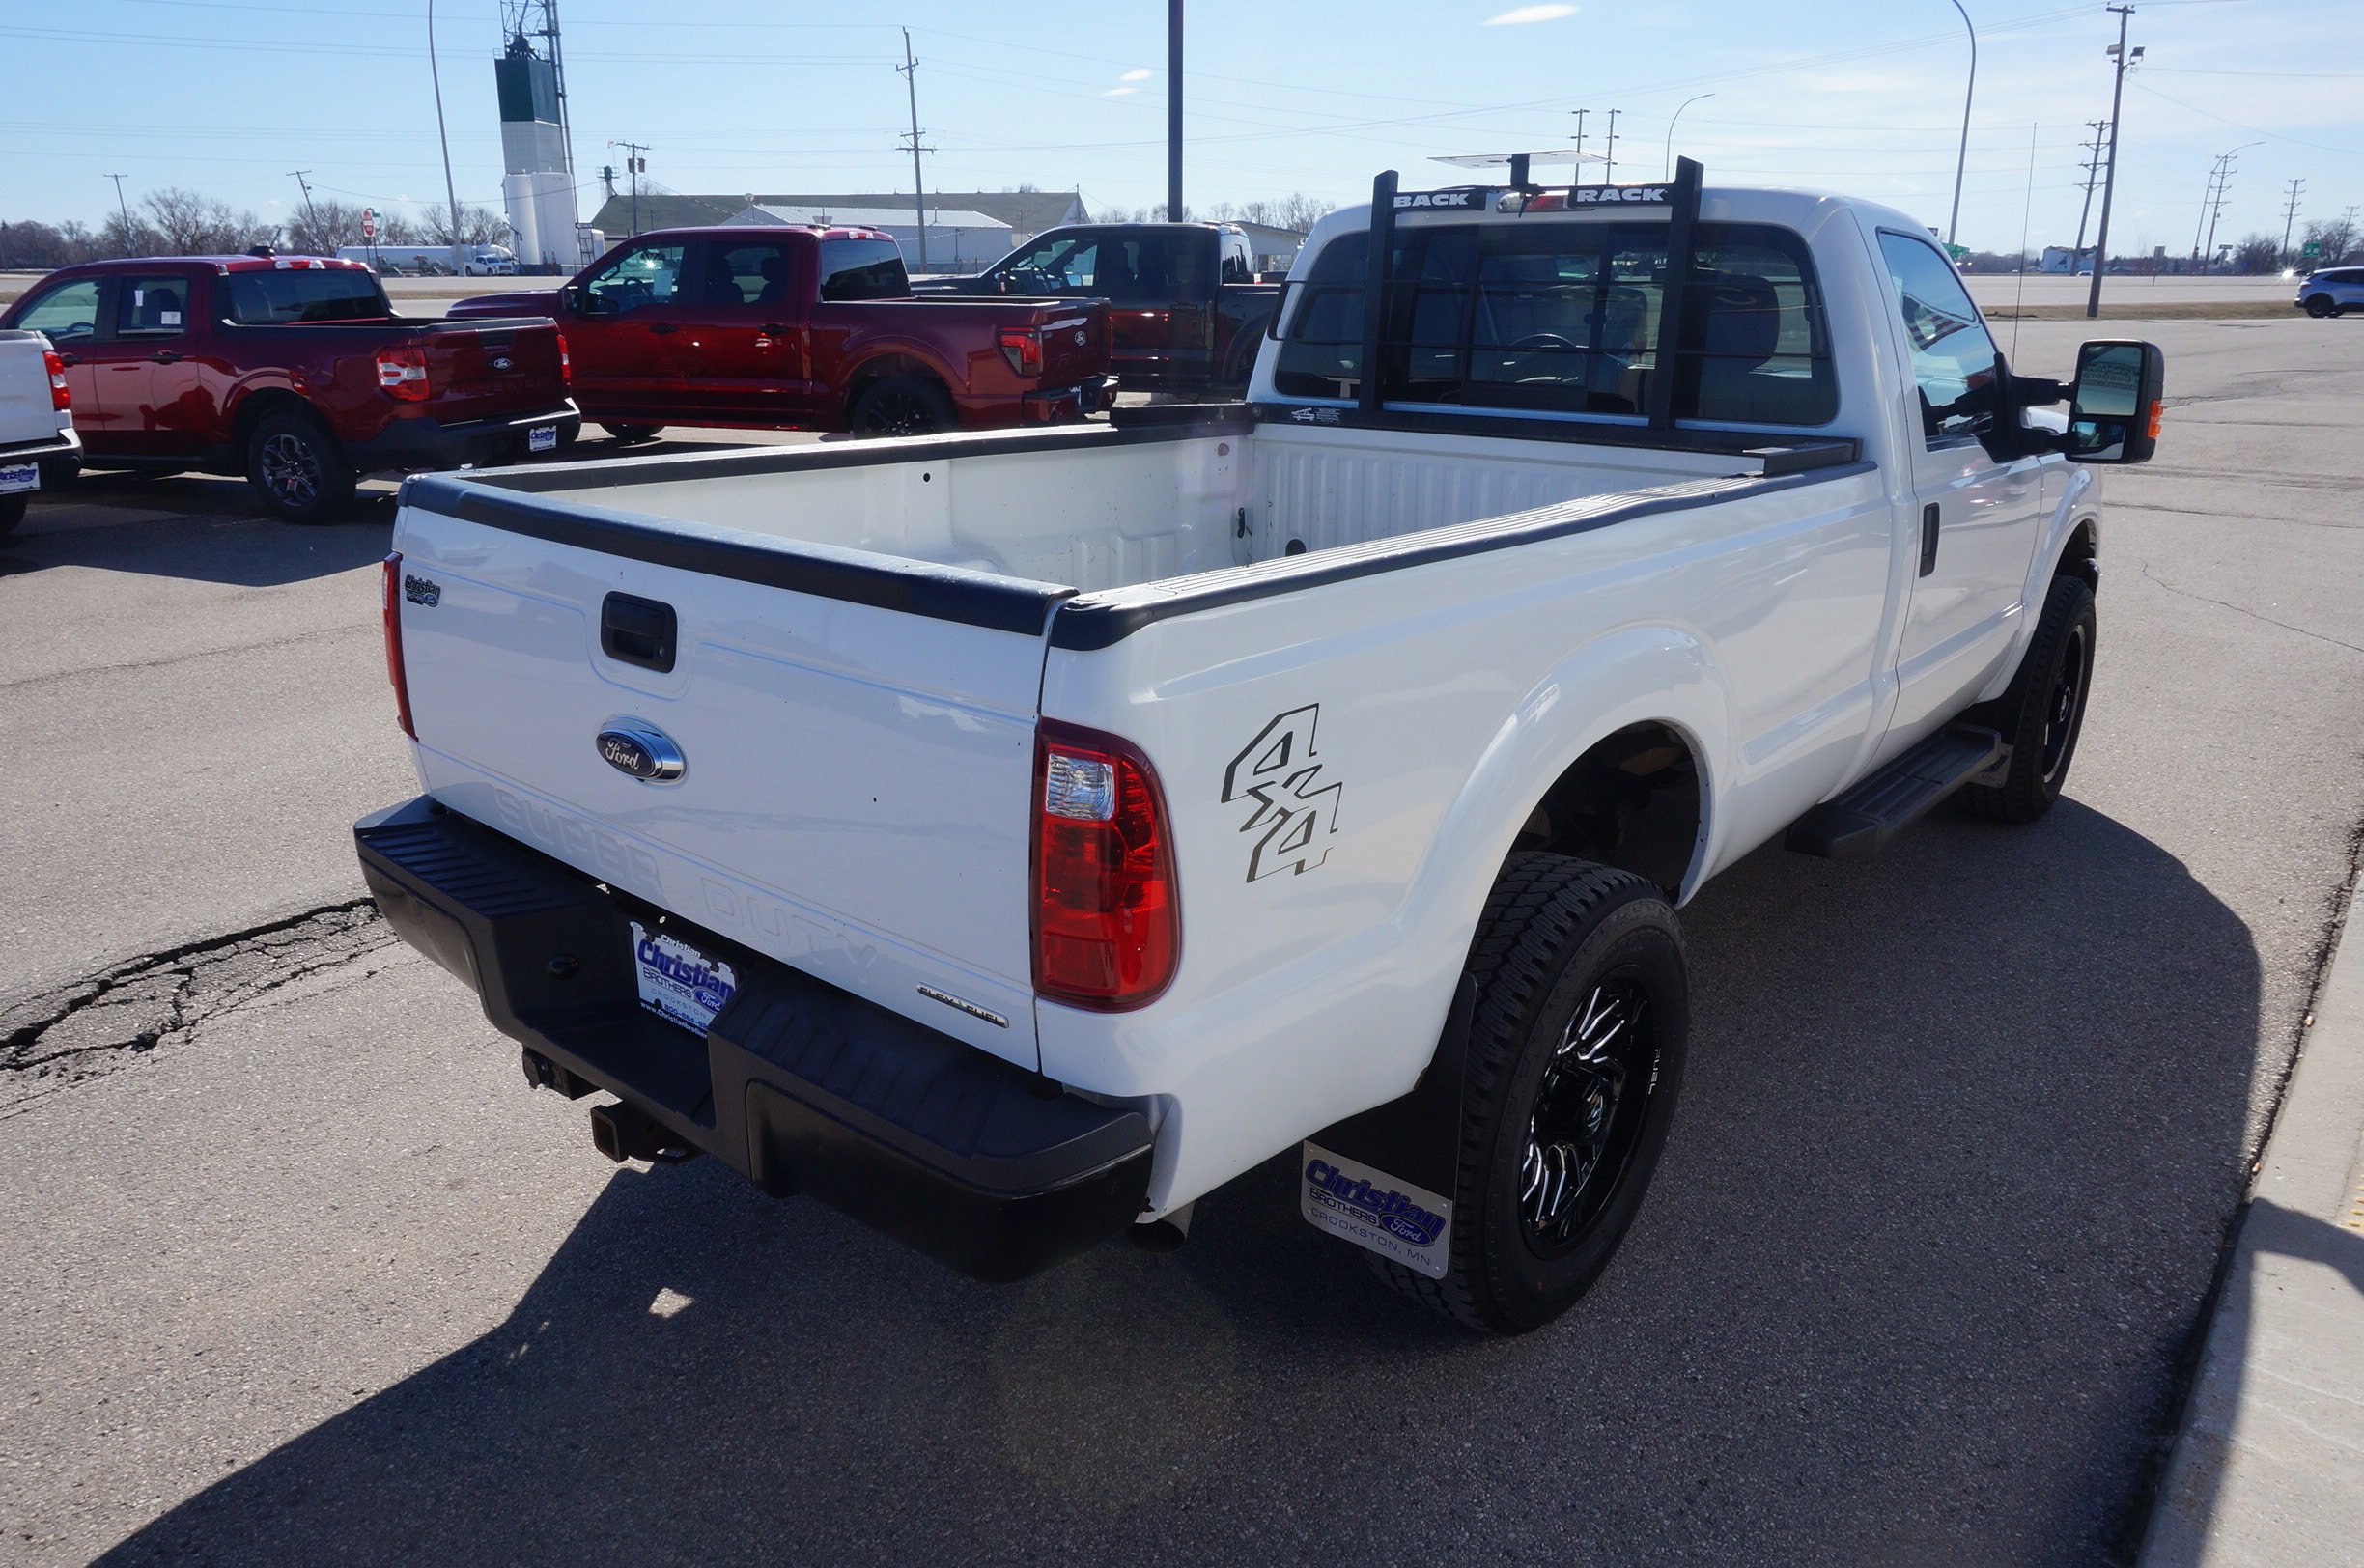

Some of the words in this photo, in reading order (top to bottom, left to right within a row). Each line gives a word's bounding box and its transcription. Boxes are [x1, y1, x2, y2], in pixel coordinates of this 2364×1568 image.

[1393, 192, 1470, 209] BACK
[1576, 187, 1666, 203] RACK
[605, 738, 640, 770] Ford
[495, 788, 664, 898] SUPER
[701, 876, 878, 984] DUTY
[661, 934, 701, 958] Christian
[637, 938, 735, 1002] Christian
[643, 966, 692, 998] BROTHERS
[700, 991, 722, 1012] Ford
[1647, 1048, 1661, 1095] FUEL
[1305, 1159, 1447, 1242] Christian
[1309, 1186, 1378, 1226] BROTHERS
[1310, 1207, 1402, 1255] CROOKSTON,
[1406, 1247, 1431, 1267] MN
[1390, 1218, 1422, 1243] Ford
